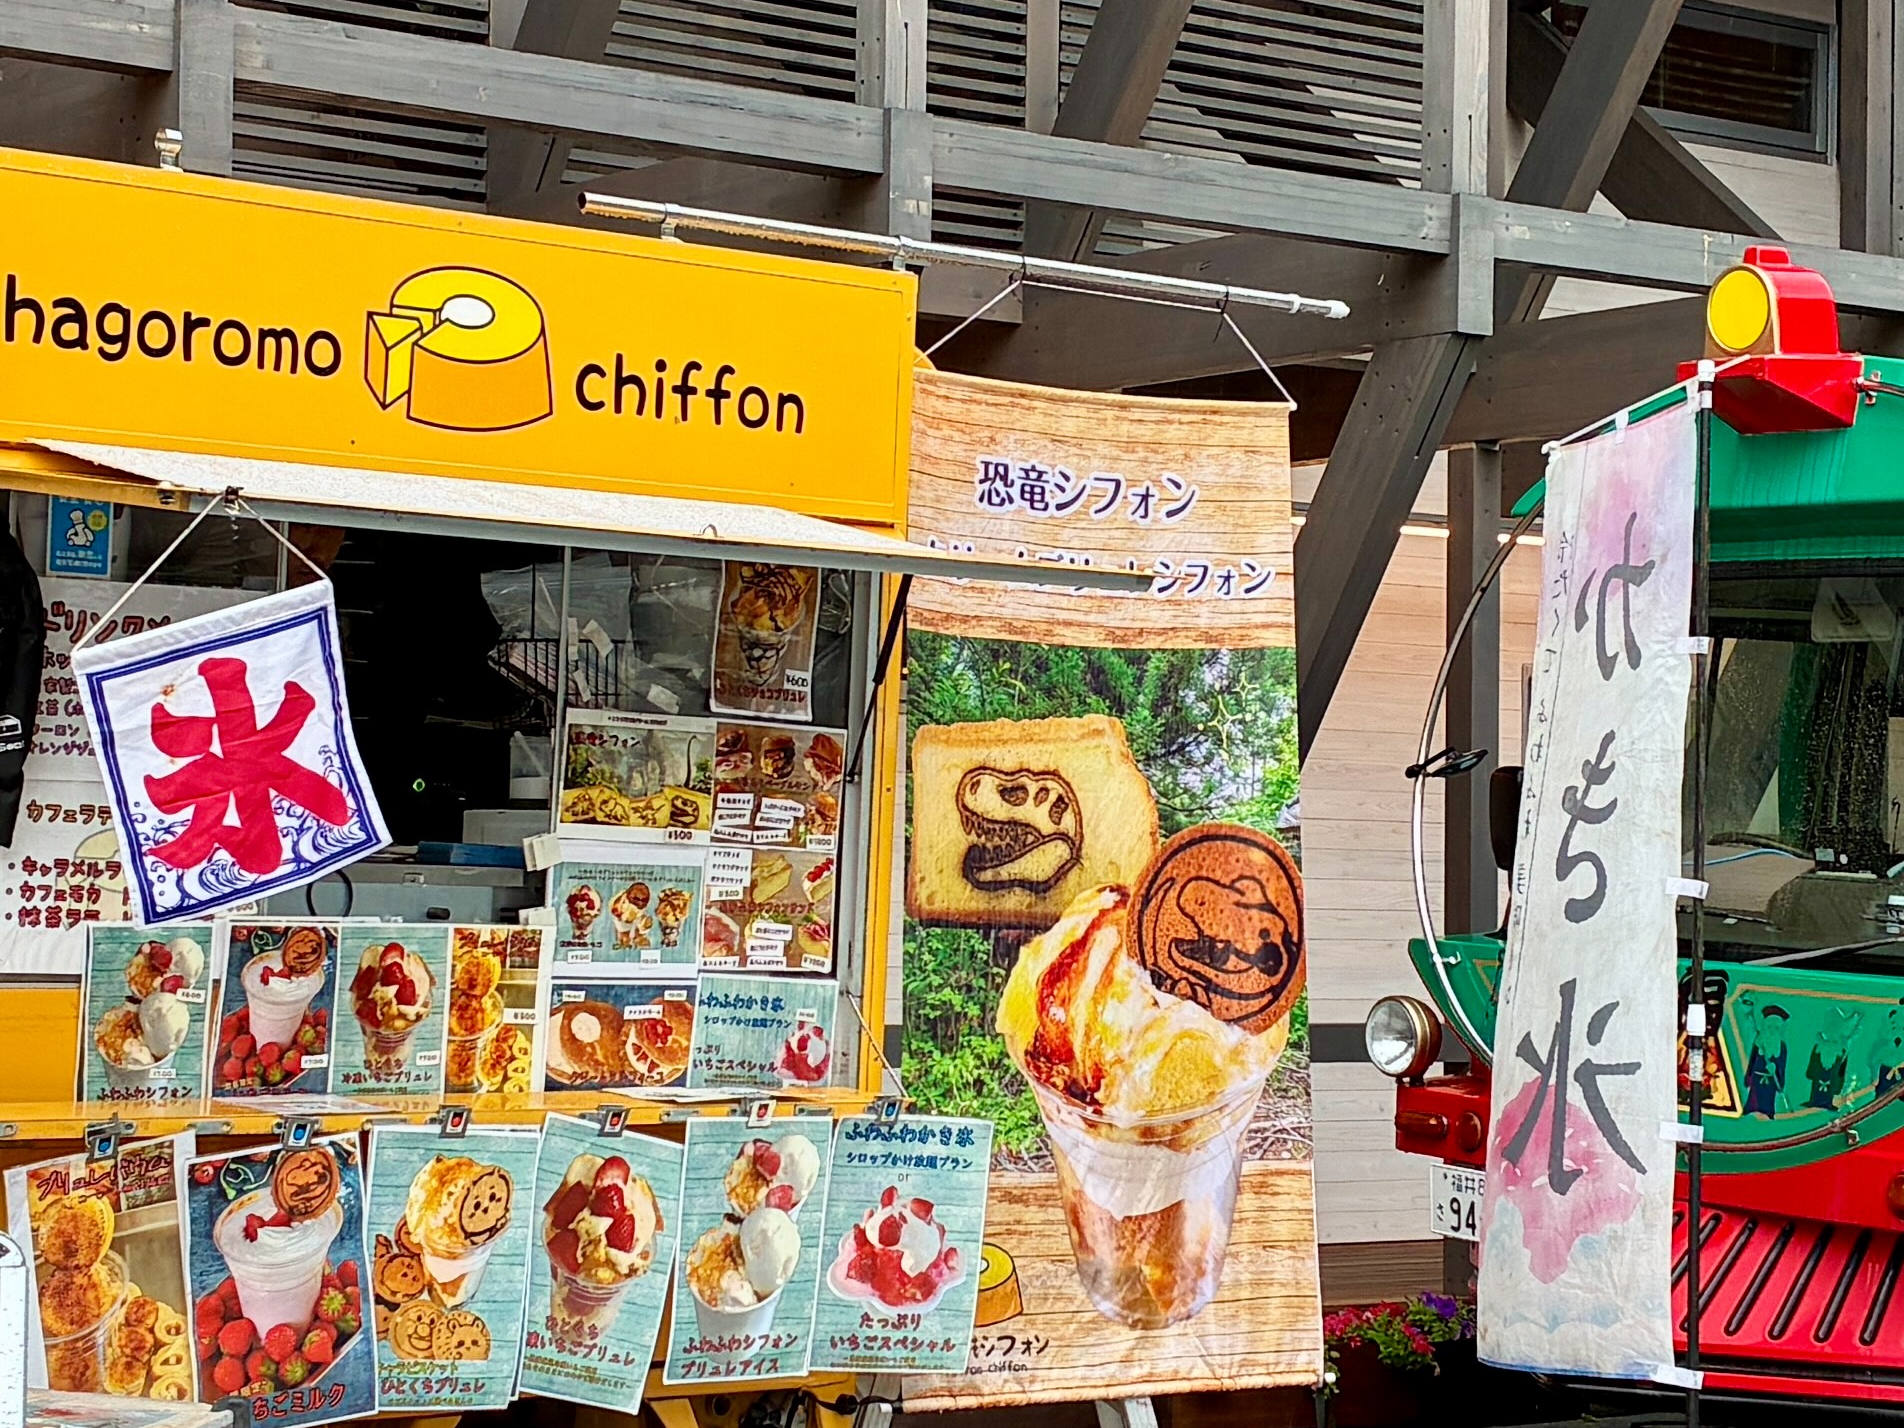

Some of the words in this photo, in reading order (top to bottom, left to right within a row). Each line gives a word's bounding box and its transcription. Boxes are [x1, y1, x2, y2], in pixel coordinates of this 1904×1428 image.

[3, 273, 343, 378] hagoromo
[574, 351, 806, 435] chiffon
[977, 458, 1197, 521] 恐竜シフォン
[142, 656, 350, 876] 氷
[19, 880, 102, 904] カフェモカ
[844, 1121, 975, 1148] ふわふわかき氷
[858, 1311, 922, 1331] たっぷり
[682, 1332, 799, 1355] ふわふわシフォン
[829, 1334, 957, 1355] いちごスペシャル
[681, 1356, 781, 1380] ブリュレアイス
[380, 1375, 486, 1397] ひとくちブリュレ
